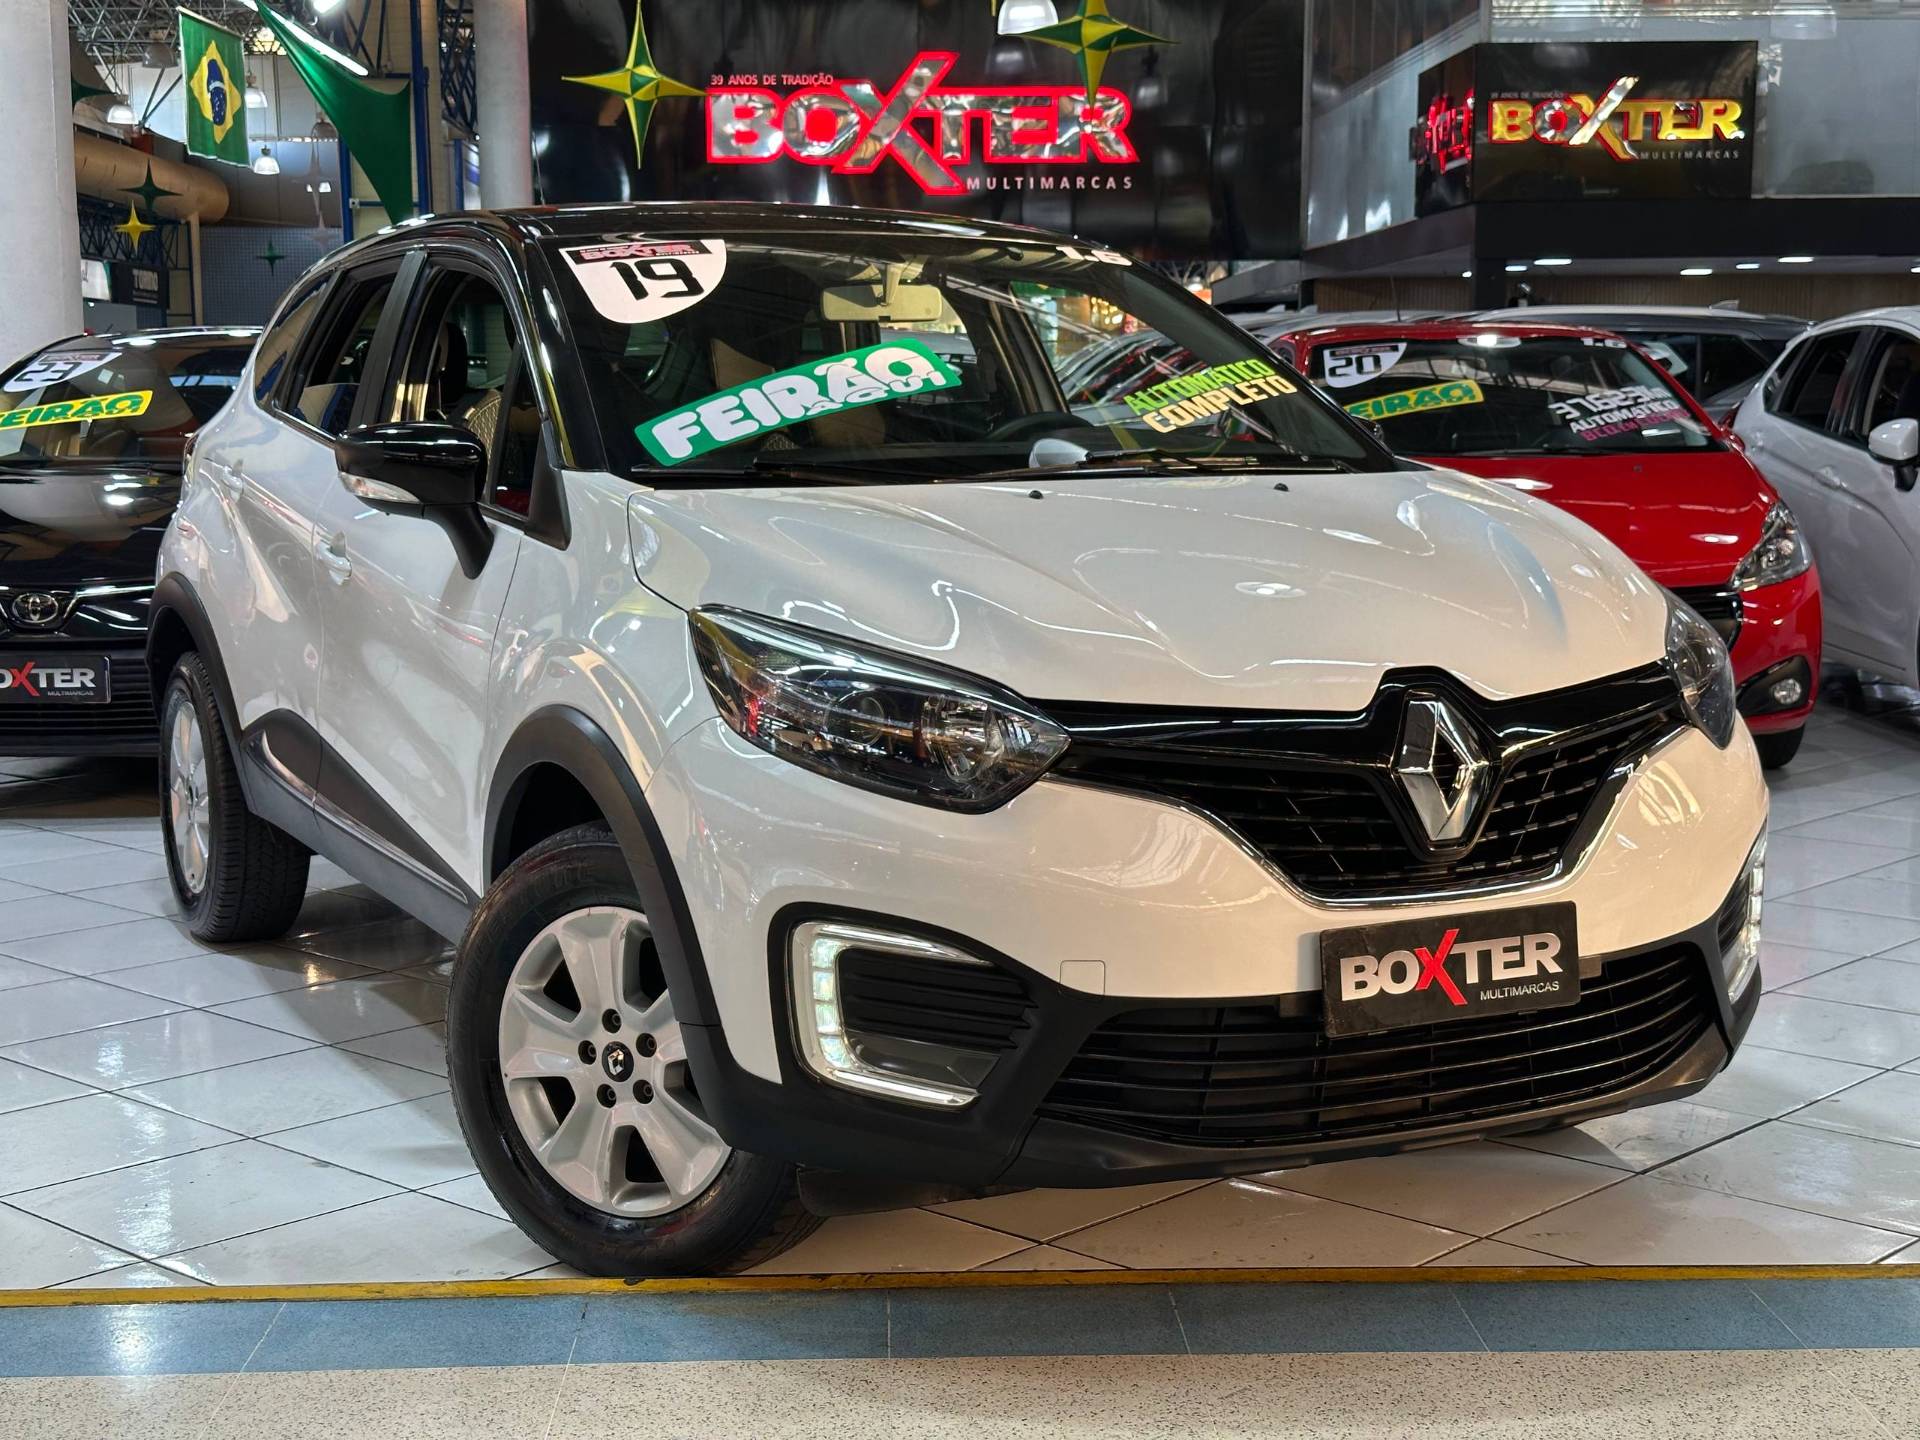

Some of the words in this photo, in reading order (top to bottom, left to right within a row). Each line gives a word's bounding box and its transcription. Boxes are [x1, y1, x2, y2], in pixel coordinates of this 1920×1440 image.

[711, 74, 723, 85] 39
[728, 74, 758, 85] ANOS
[763, 74, 777, 85] DE
[781, 72, 834, 88] TRADIÇÃO
[706, 51, 1140, 196] BOXTER
[1488, 76, 1745, 161] BOXTER
[1641, 150, 1740, 160] MULTIMARCAS
[966, 176, 1133, 190] MULTIMARCAS
[1055, 246, 1133, 267] 1.6
[609, 258, 705, 301] 19
[1328, 354, 1382, 377] 20
[0, 394, 143, 427] EIRÃO
[651, 347, 936, 459] FEIRÃO
[1142, 375, 1298, 433] COMPLETO
[1349, 384, 1476, 419] EIRÃO
[0, 661, 96, 697] OXTER
[1340, 928, 1563, 1006] BOXTER
[1480, 981, 1560, 1001] MULTIMARCAS
